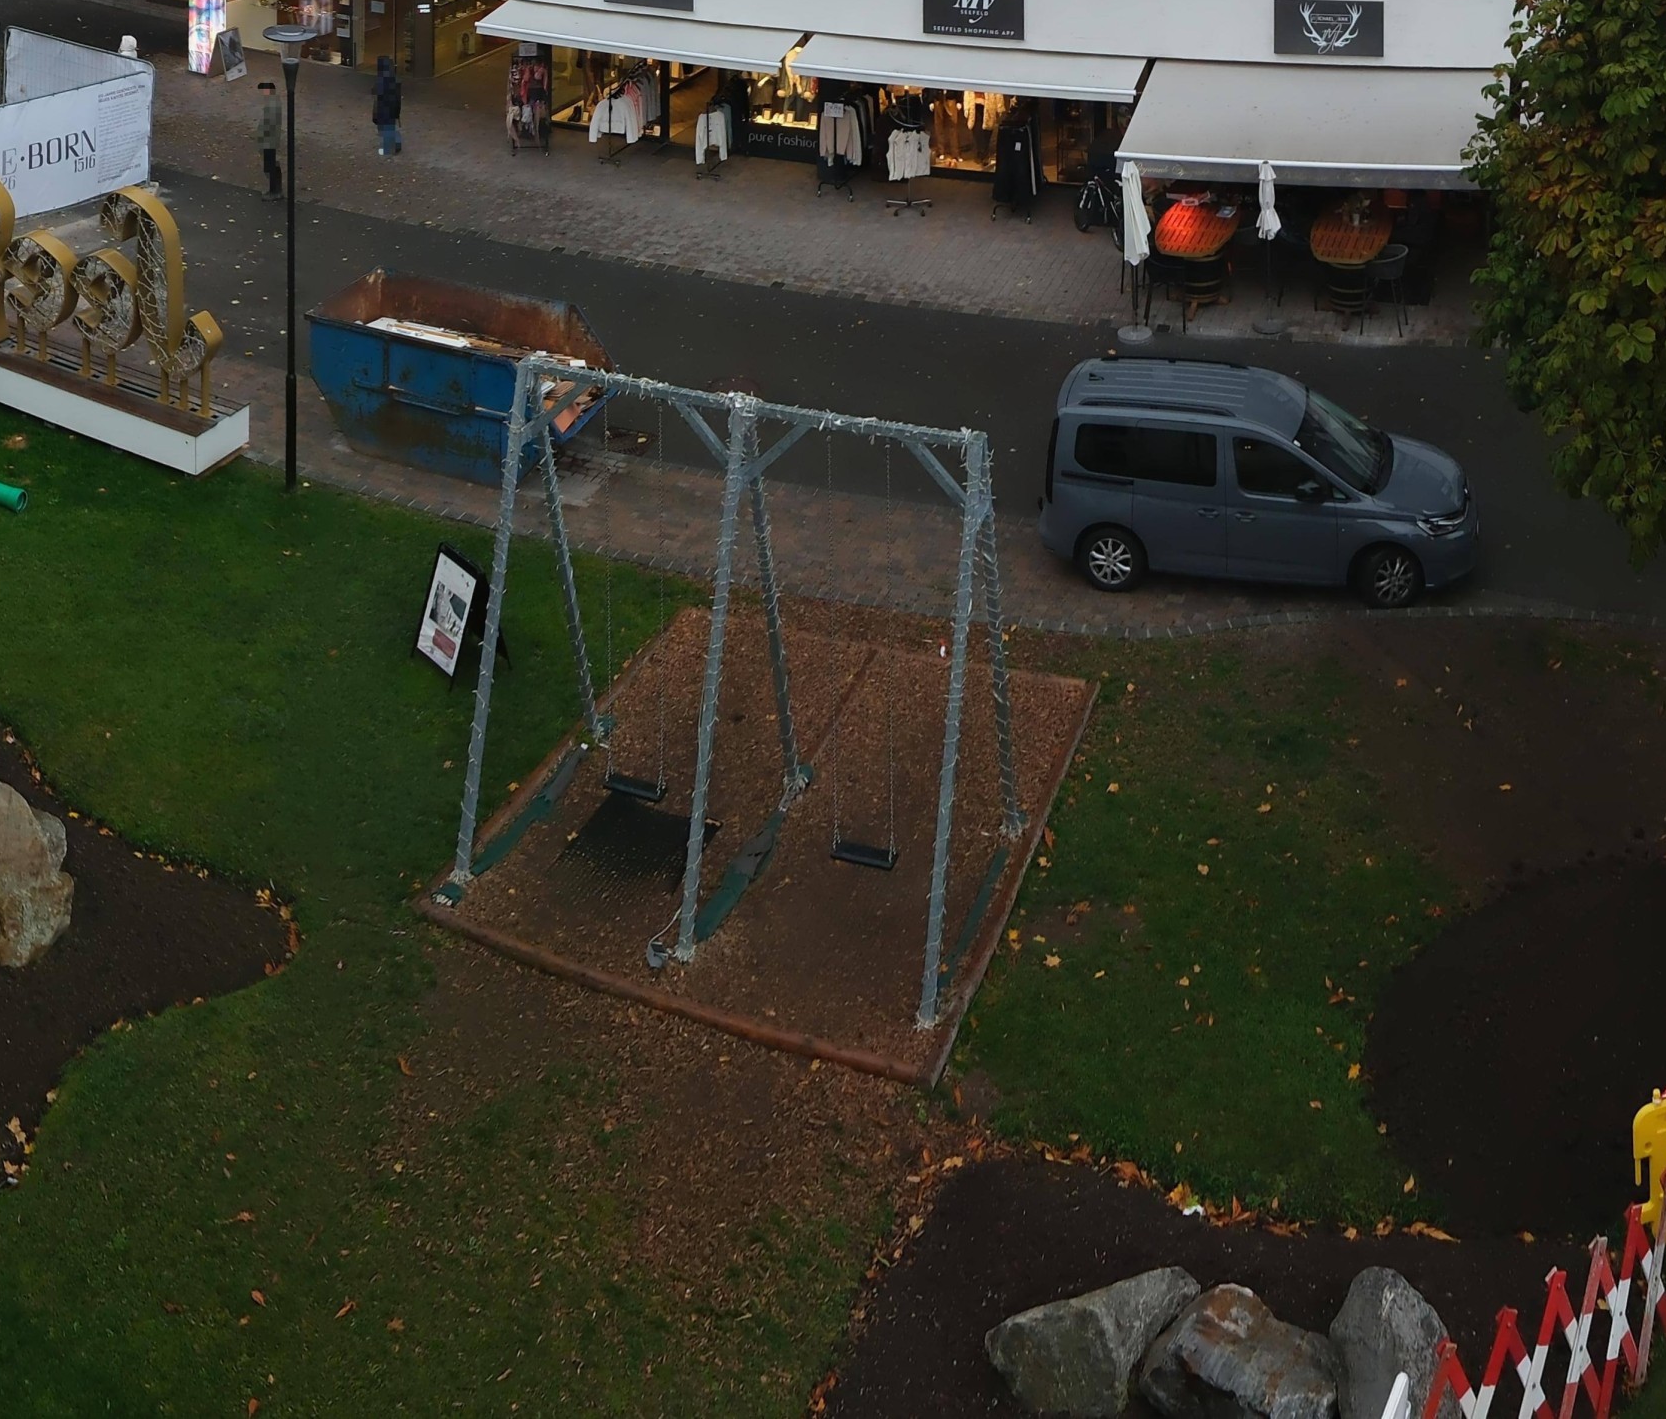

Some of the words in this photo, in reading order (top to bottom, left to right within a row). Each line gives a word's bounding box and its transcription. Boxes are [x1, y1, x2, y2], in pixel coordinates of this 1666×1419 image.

[748, 133, 774, 144] pure
[0, 175, 16, 190] 26
[74, 154, 96, 174] 1516
